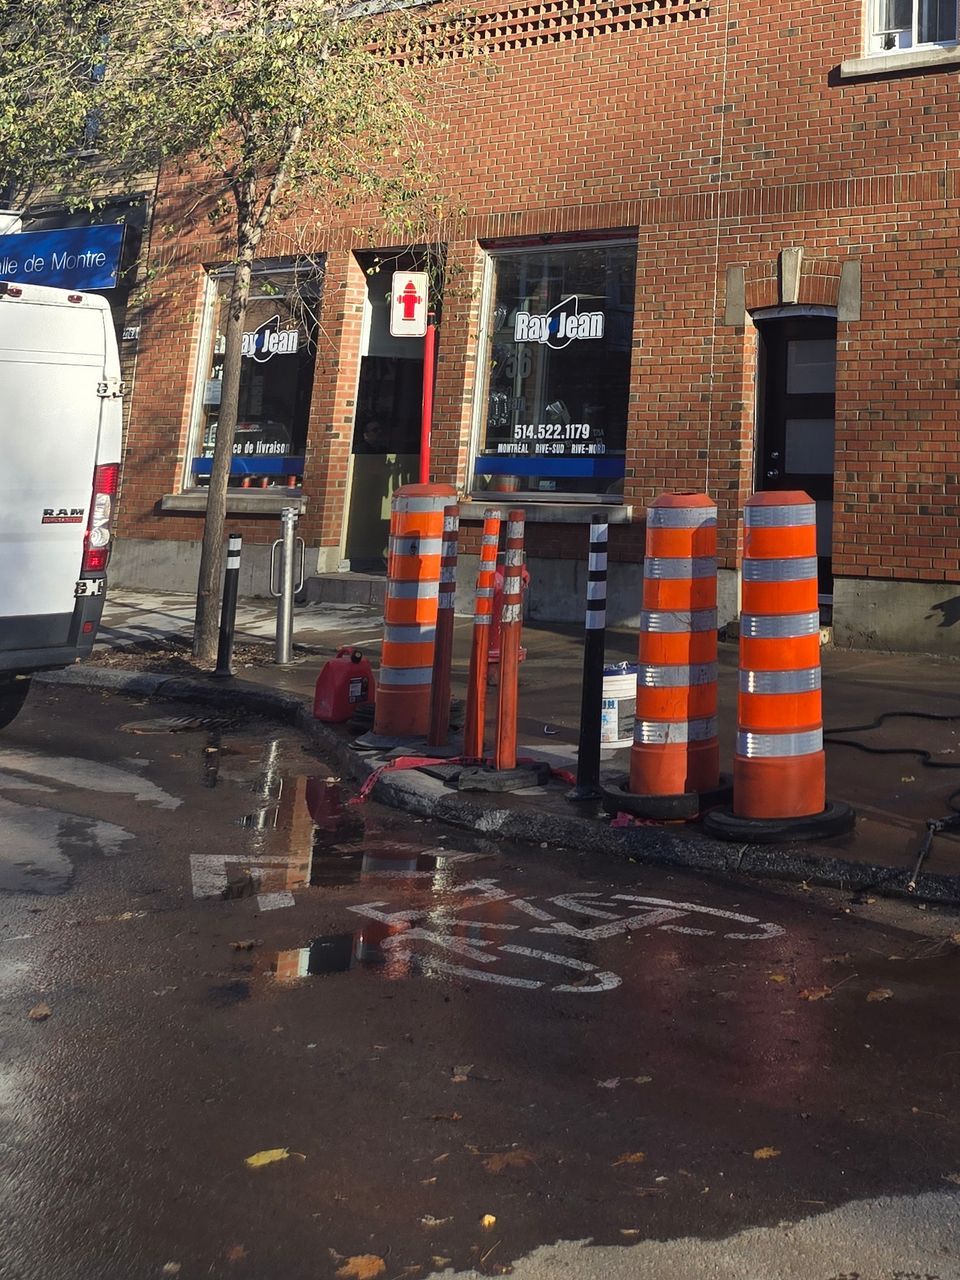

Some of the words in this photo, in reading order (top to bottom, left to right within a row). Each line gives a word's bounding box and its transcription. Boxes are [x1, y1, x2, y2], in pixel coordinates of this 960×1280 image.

[24, 254, 45, 273] de
[51, 250, 107, 271] Montre
[515, 313, 552, 342] Ray
[556, 311, 604, 339] Jean
[241, 332, 259, 356] ay
[260, 328, 299, 354] Jean
[514, 423, 591, 440] 514.522.1179
[244, 441, 254, 454] de
[255, 440, 291, 455] livraison
[497, 441, 529, 454] MONTRÉAL
[535, 443, 565, 455] RIVE-SUD
[571, 443, 607, 455] RIVE-NORD
[43, 508, 85, 517] RAM
